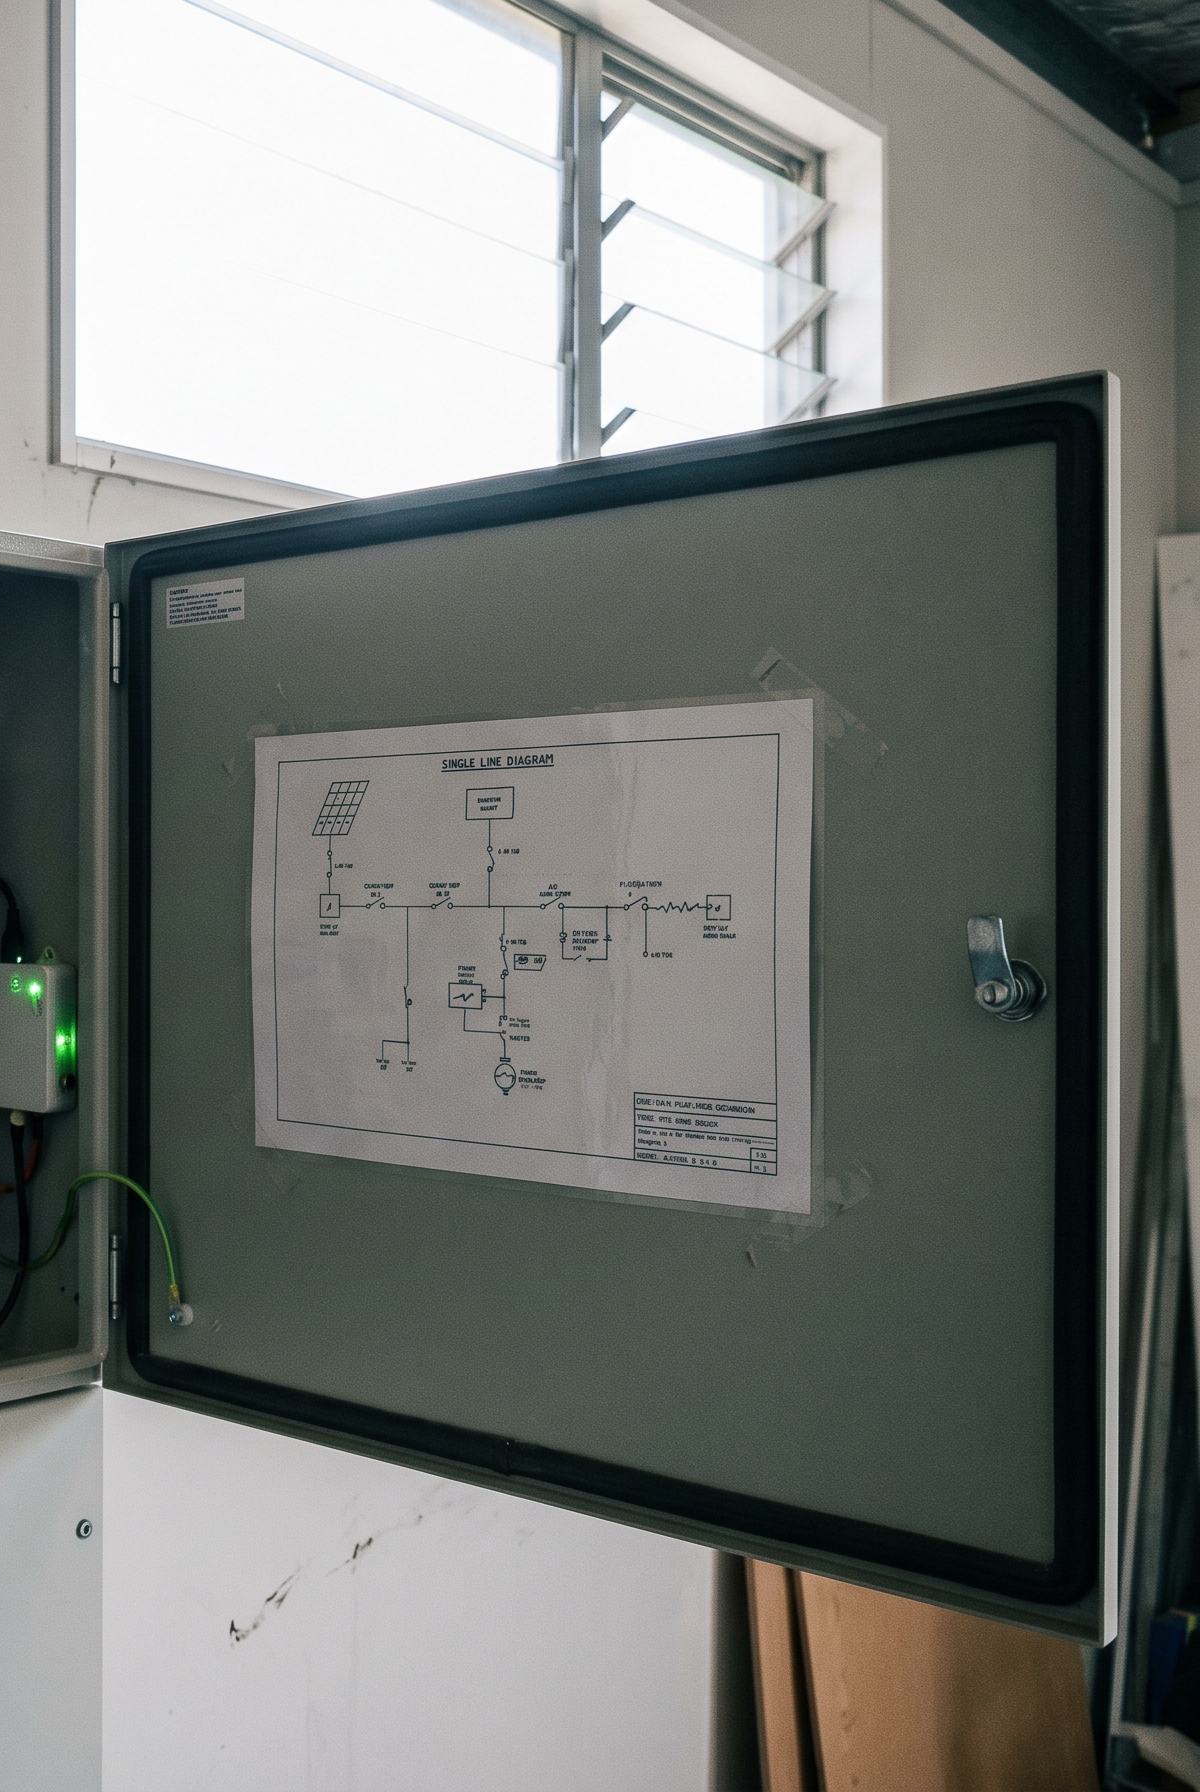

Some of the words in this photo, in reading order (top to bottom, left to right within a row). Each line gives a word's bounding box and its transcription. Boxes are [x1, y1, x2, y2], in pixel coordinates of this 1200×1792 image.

[442, 758, 475, 769] SINGLE
[480, 757, 502, 767] LINE
[507, 754, 554, 766] DIAGRAM
